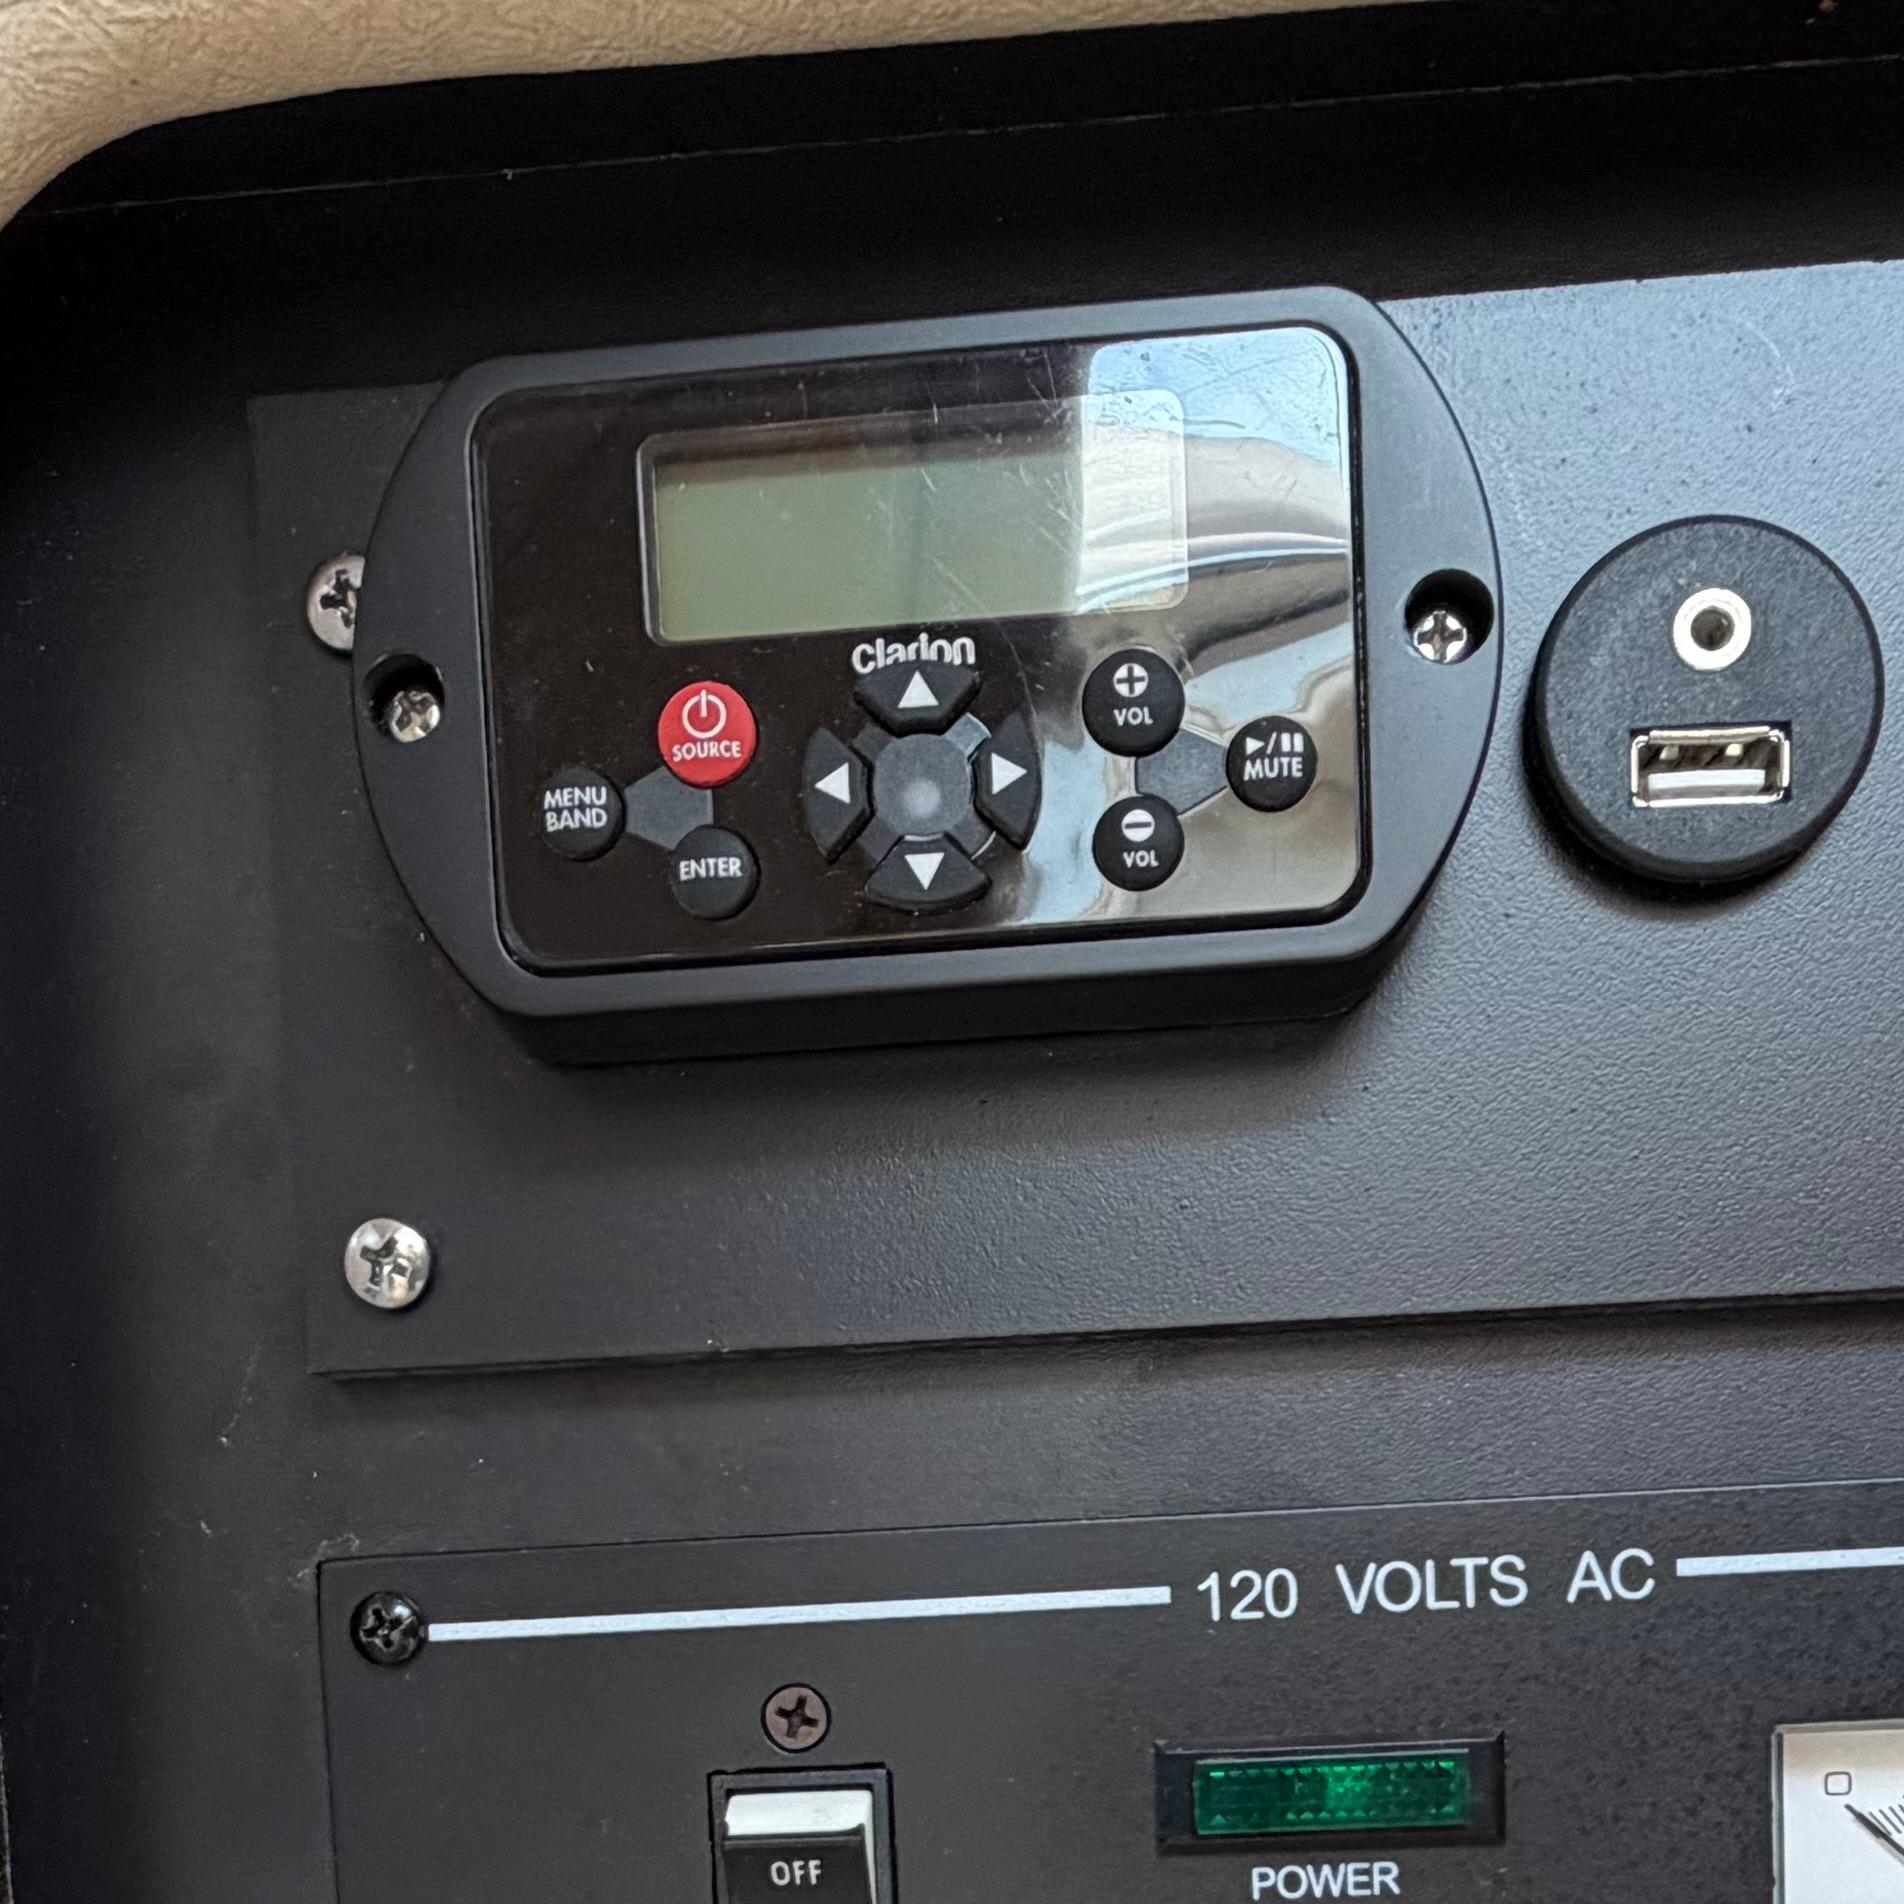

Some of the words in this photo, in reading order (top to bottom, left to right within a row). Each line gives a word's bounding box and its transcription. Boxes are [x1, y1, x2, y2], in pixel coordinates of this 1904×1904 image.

[1114, 707, 1153, 726] VOL
[671, 739, 742, 761] SOURCE
[1244, 757, 1303, 781] MUTE
[543, 786, 607, 810] MENU
[545, 808, 608, 833] BAND
[679, 856, 743, 881] ENTER
[1123, 850, 1160, 868] VOL
[1197, 1567, 1299, 1621] 120
[1335, 1554, 1530, 1615] VOLTS
[1565, 1547, 1656, 1604] AC
[1824, 1771, 1853, 1796] 0
[771, 1859, 823, 1886] OFF
[1251, 1861, 1401, 1902] POWER
